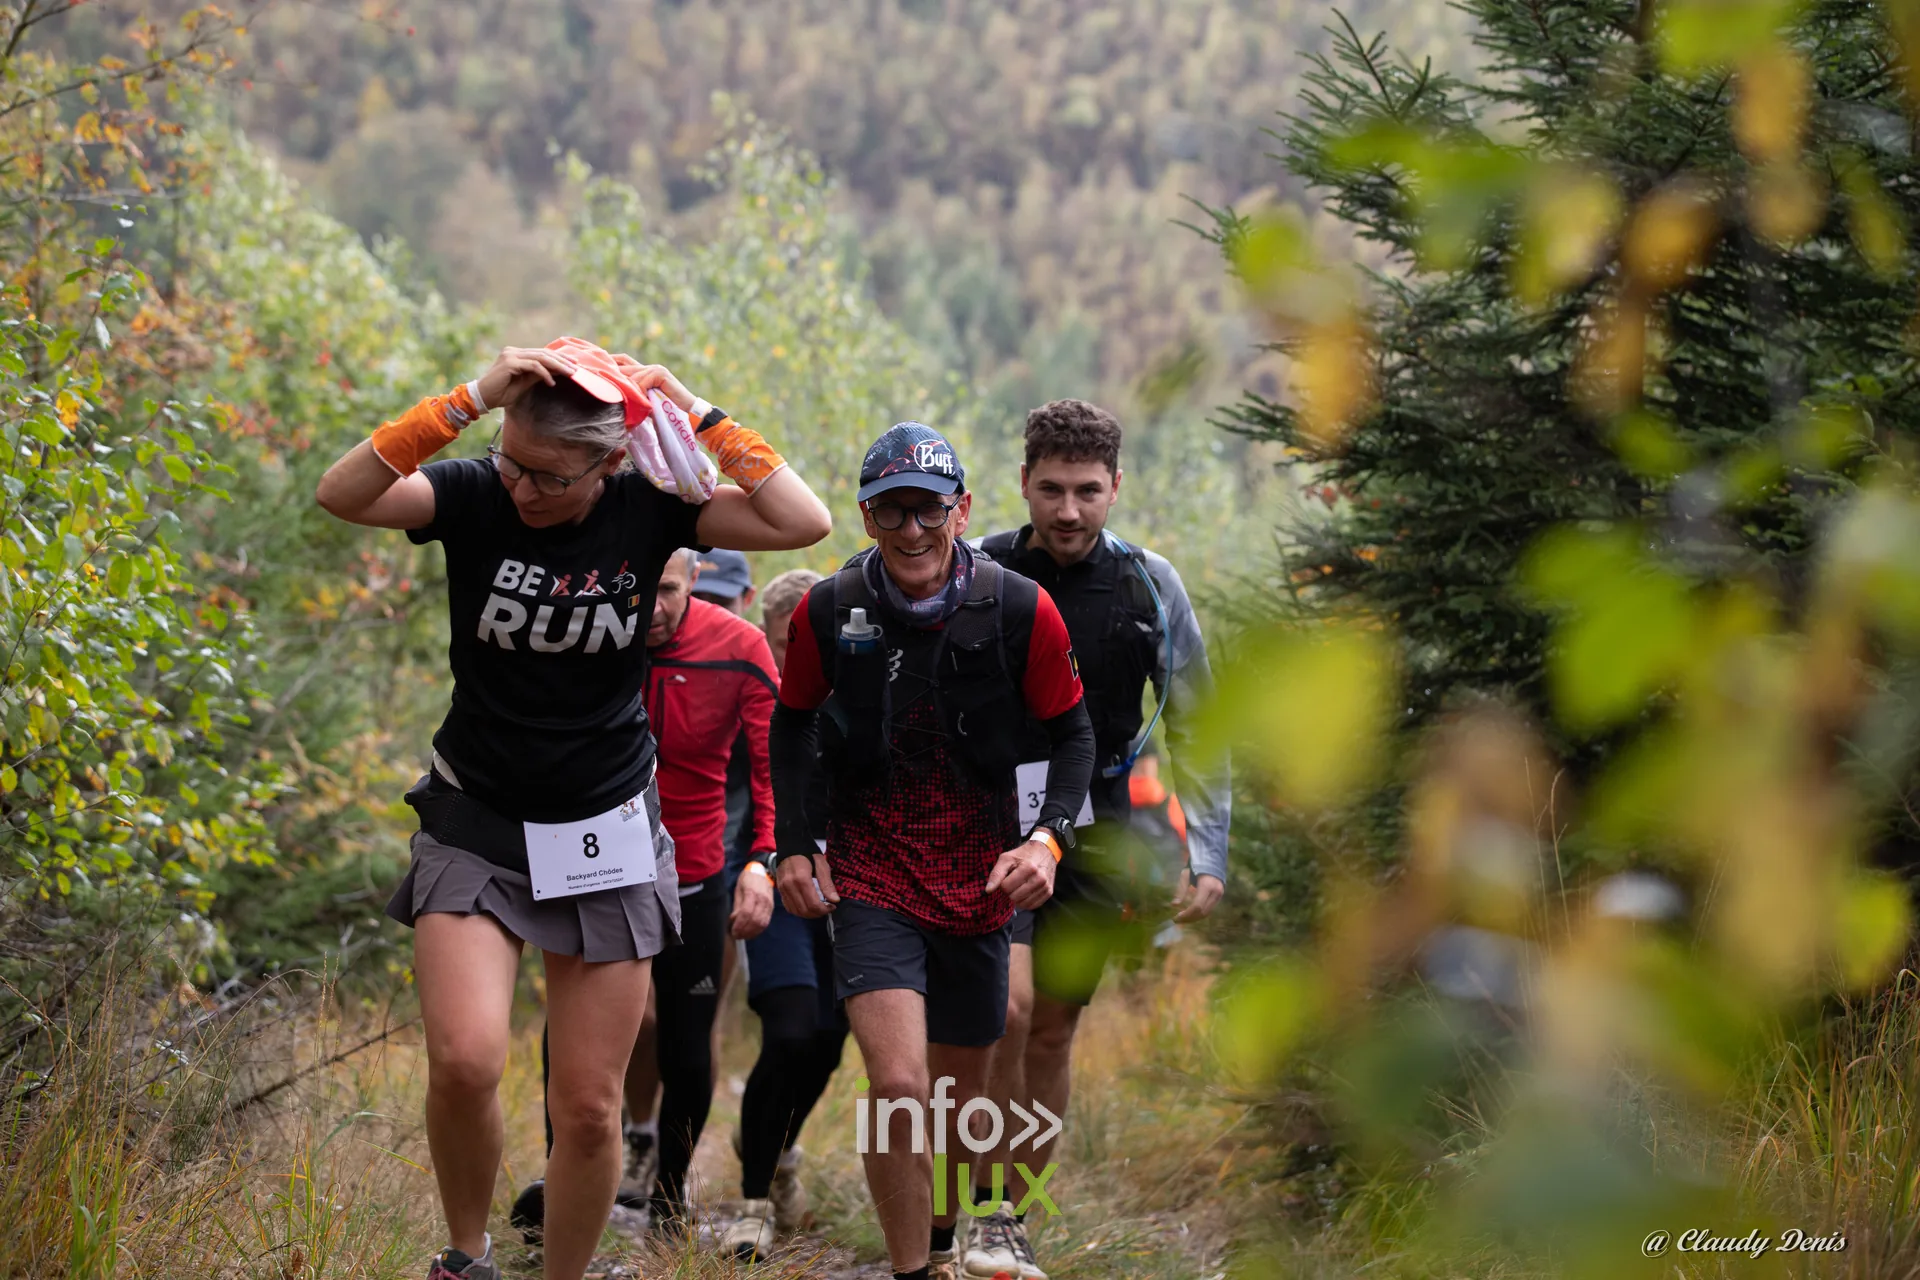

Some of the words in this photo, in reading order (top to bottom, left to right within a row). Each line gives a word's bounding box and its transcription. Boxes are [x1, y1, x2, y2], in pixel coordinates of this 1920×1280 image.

[662, 401, 697, 452] Cofidis
[492, 558, 546, 597] BE
[476, 592, 638, 654] RUN
[582, 832, 600, 858] 8
[566, 871, 598, 881] Backyard
